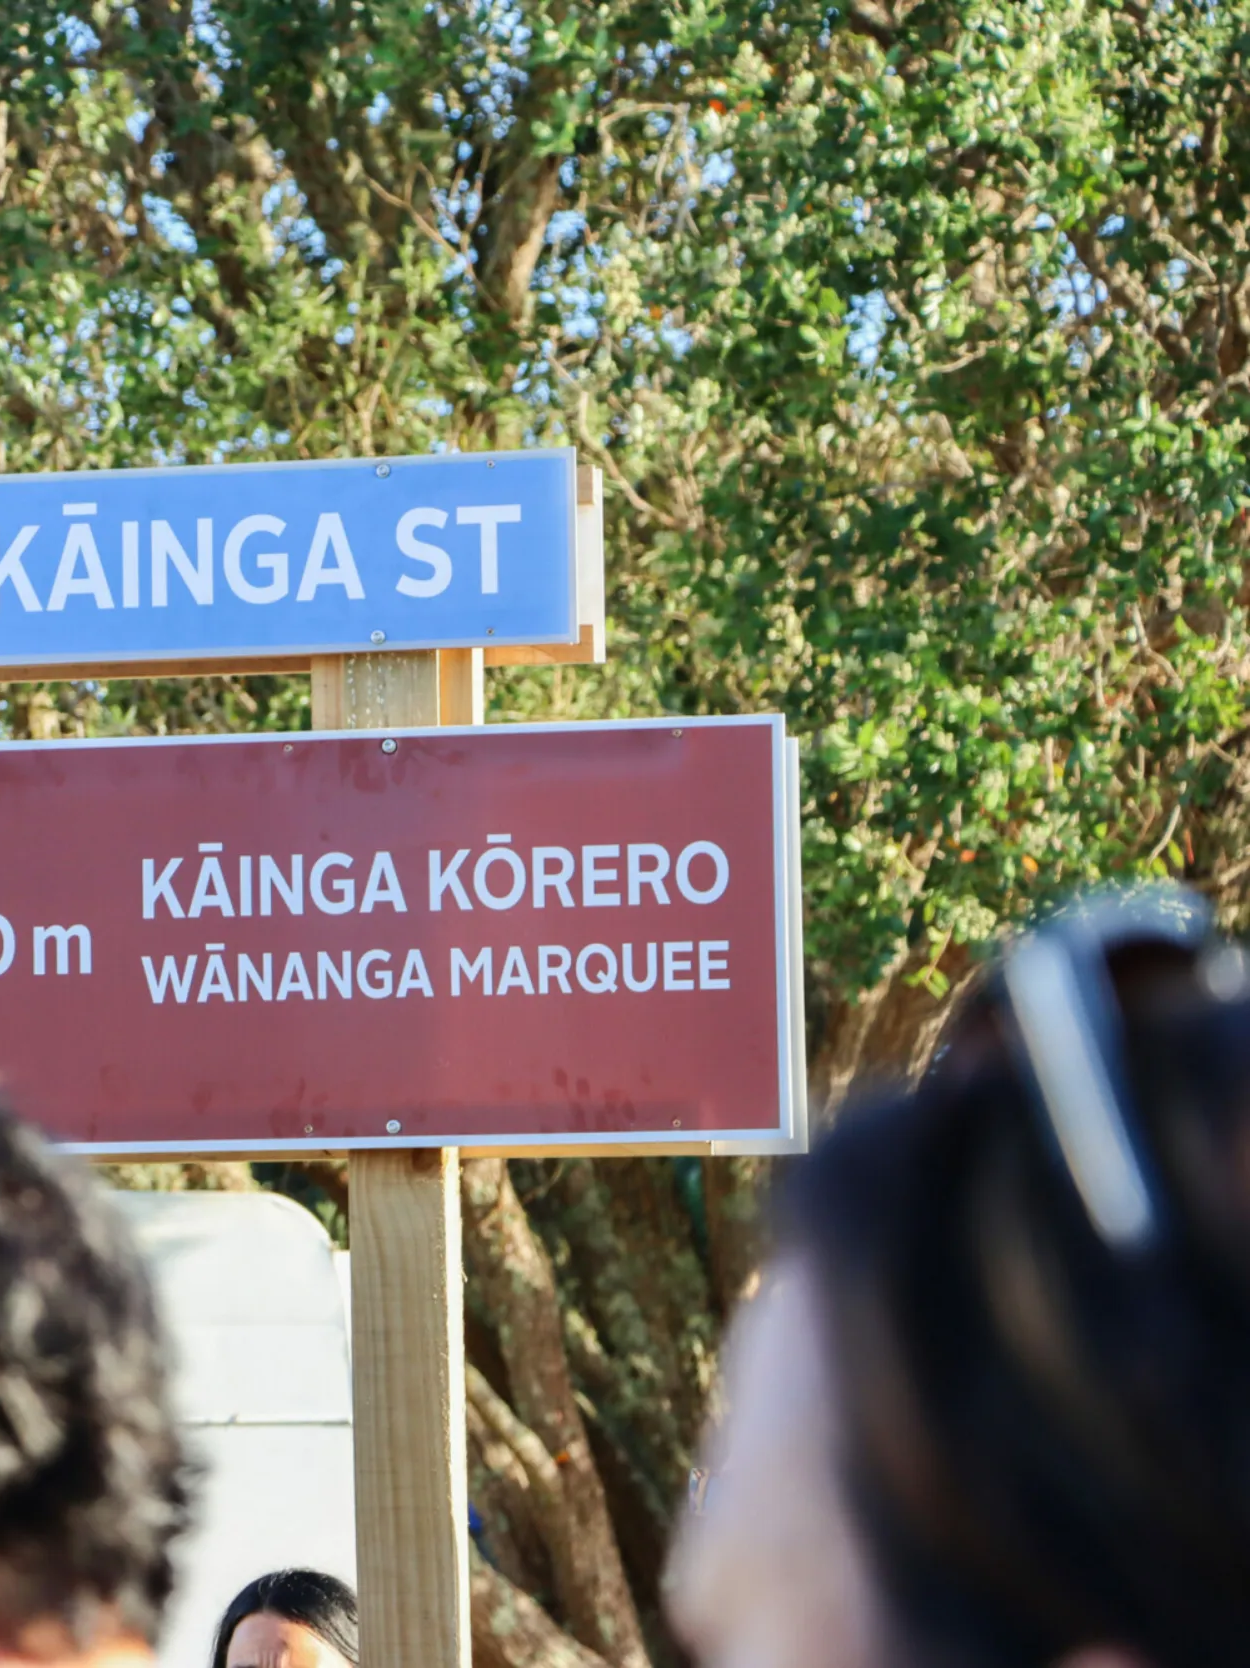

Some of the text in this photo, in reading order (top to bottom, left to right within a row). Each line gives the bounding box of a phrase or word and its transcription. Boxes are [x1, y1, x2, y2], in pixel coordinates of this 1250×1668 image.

[396, 504, 521, 597] ST
[143, 834, 729, 919] KĀINGA KŌRERO
[34, 924, 91, 975] m
[142, 941, 730, 1003] WĀNANGA MARQUEE
